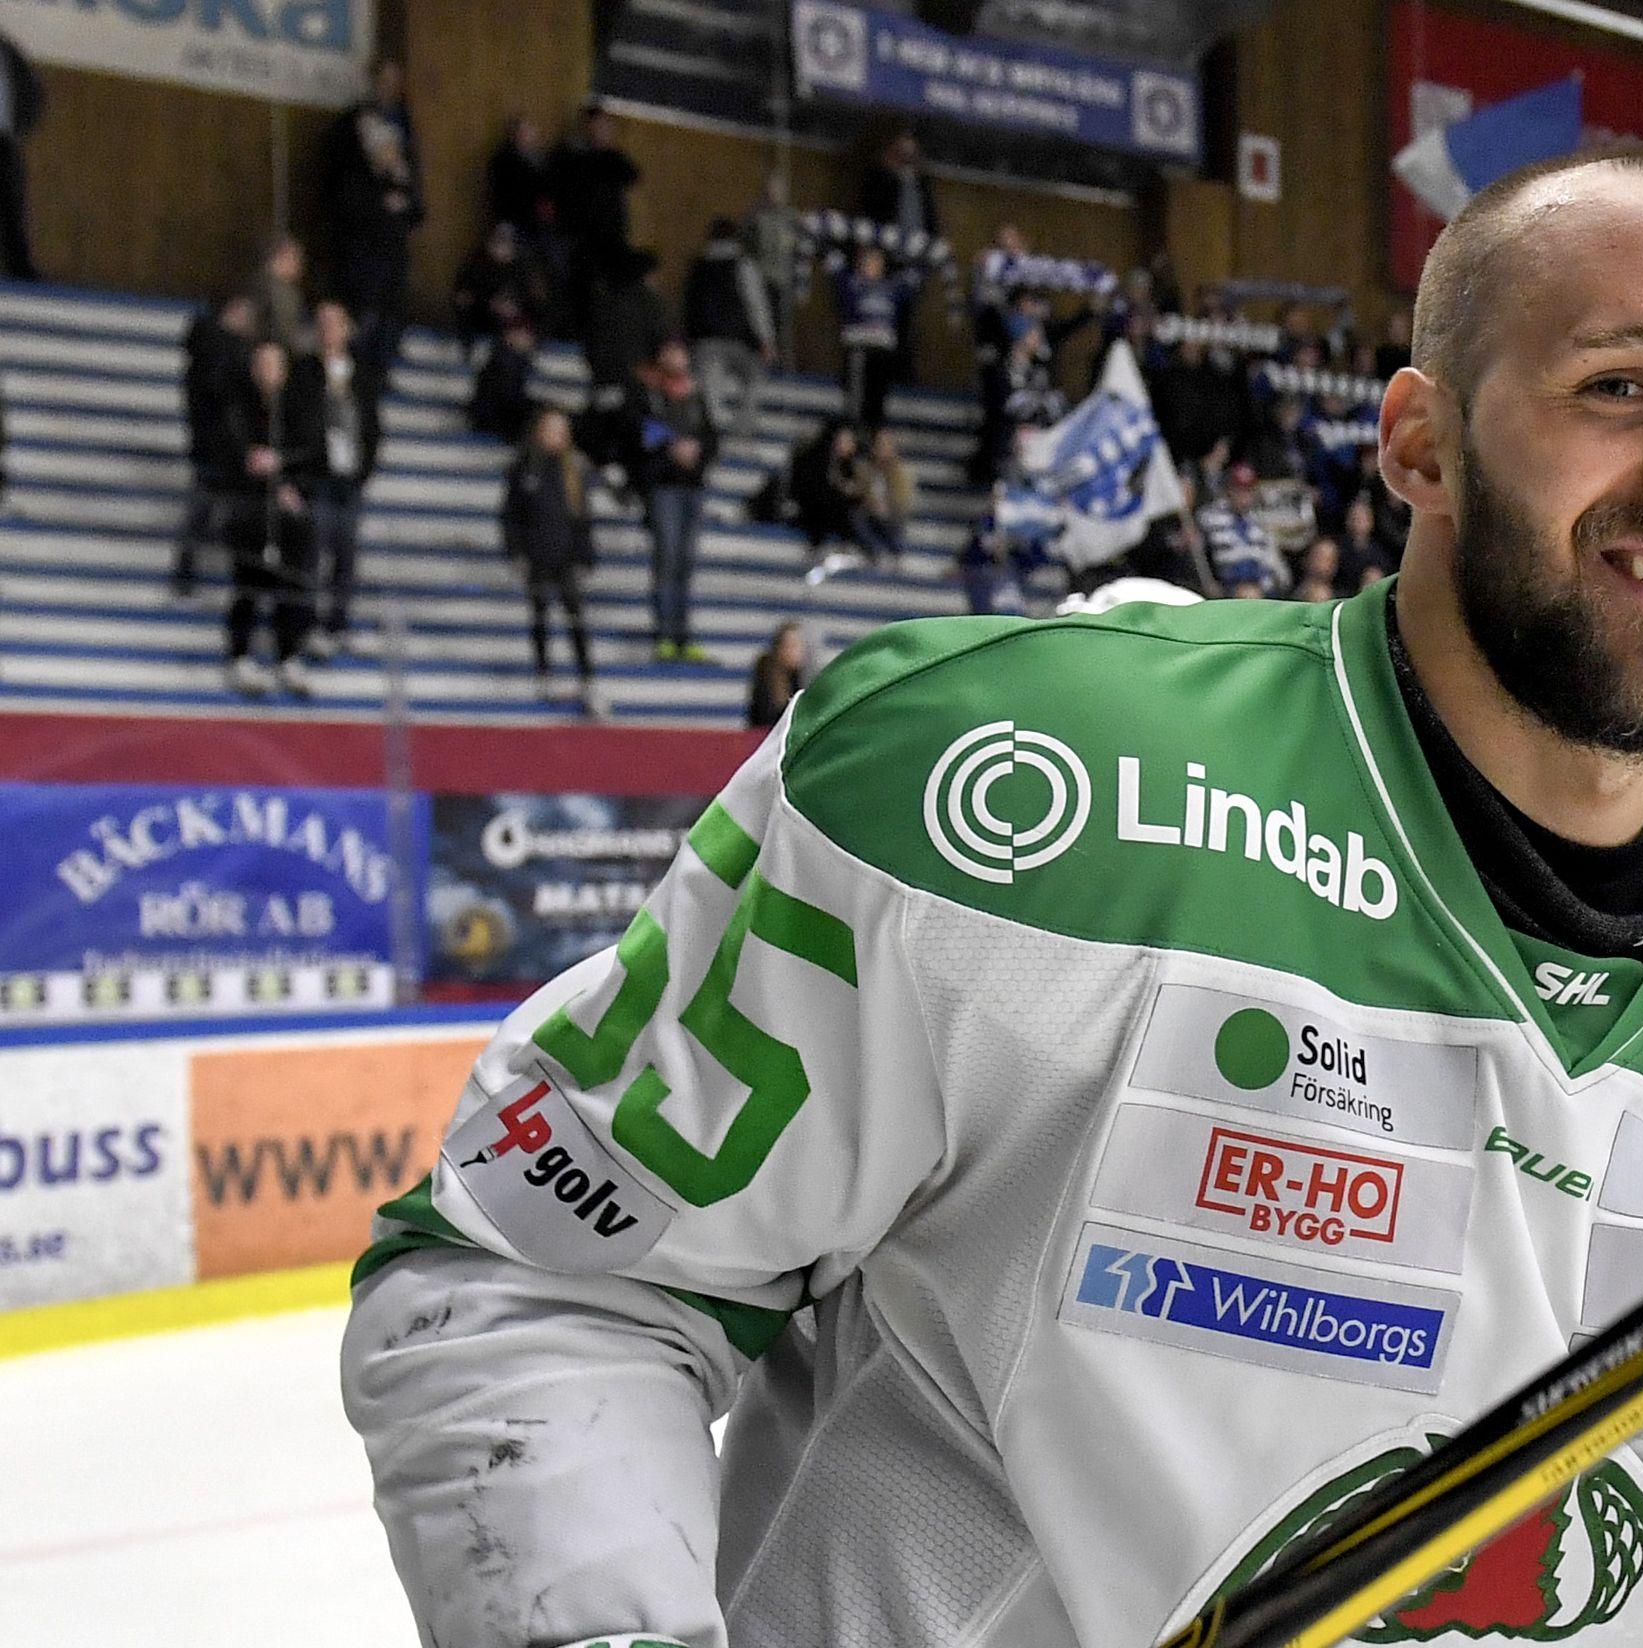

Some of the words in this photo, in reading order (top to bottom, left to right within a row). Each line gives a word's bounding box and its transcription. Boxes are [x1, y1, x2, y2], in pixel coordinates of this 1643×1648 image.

[55, 791, 397, 902] BÄCKMANS
[1117, 756, 1399, 921] Lindab
[140, 880, 247, 938] RÖR
[257, 890, 336, 938] AB
[532, 799, 858, 1209] 55
[1533, 961, 1612, 1008] SHL
[1296, 1024, 1369, 1086] Solid
[1290, 1072, 1394, 1133] Försäkring
[197, 1128, 416, 1208] www
[523, 1145, 639, 1239] golv
[1213, 1143, 1390, 1220] ER-HO
[1249, 1204, 1346, 1247] BYGG
[1211, 1275, 1427, 1364] Wihlborgs
